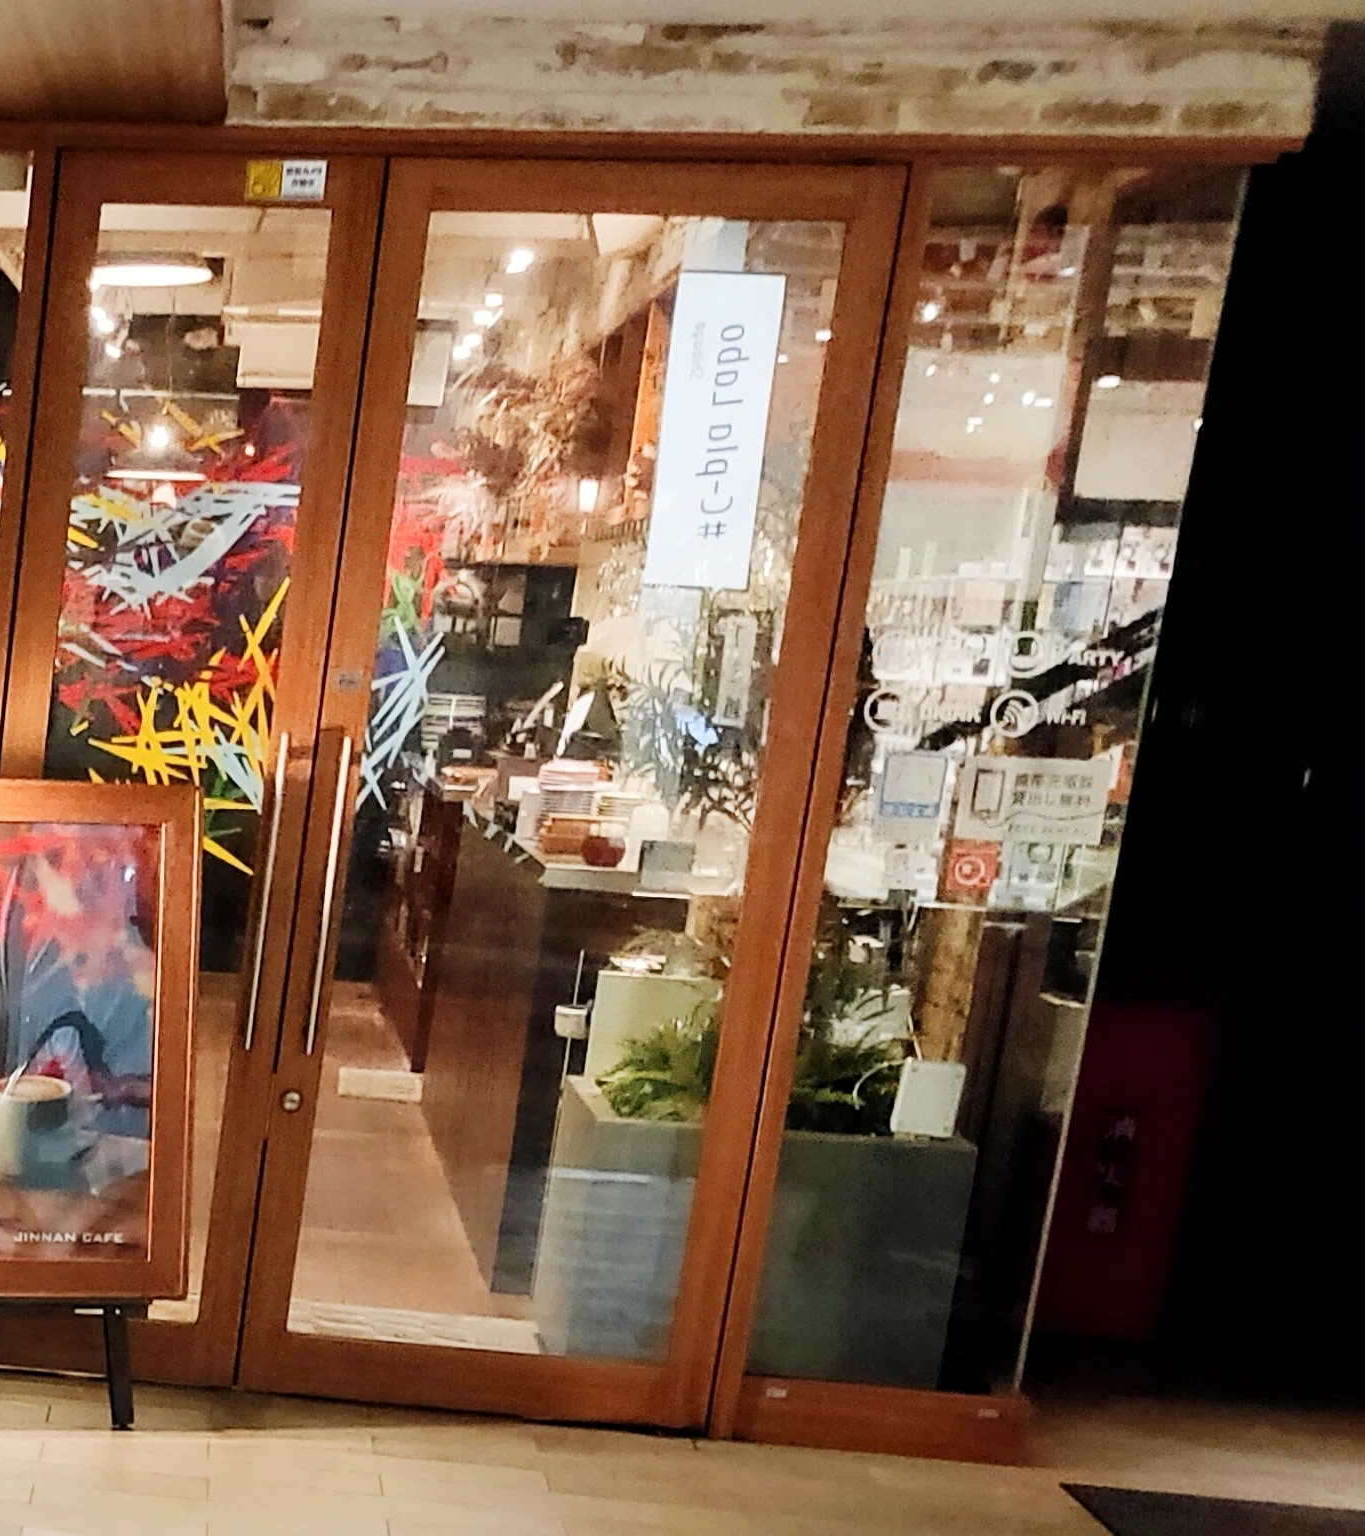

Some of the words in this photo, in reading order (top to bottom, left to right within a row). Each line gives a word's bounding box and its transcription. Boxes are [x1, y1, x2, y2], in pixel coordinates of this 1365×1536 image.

[1056, 648, 1125, 667] ARTY
[13, 1232, 76, 1244] JINNAN
[82, 1232, 124, 1244] CAFE
